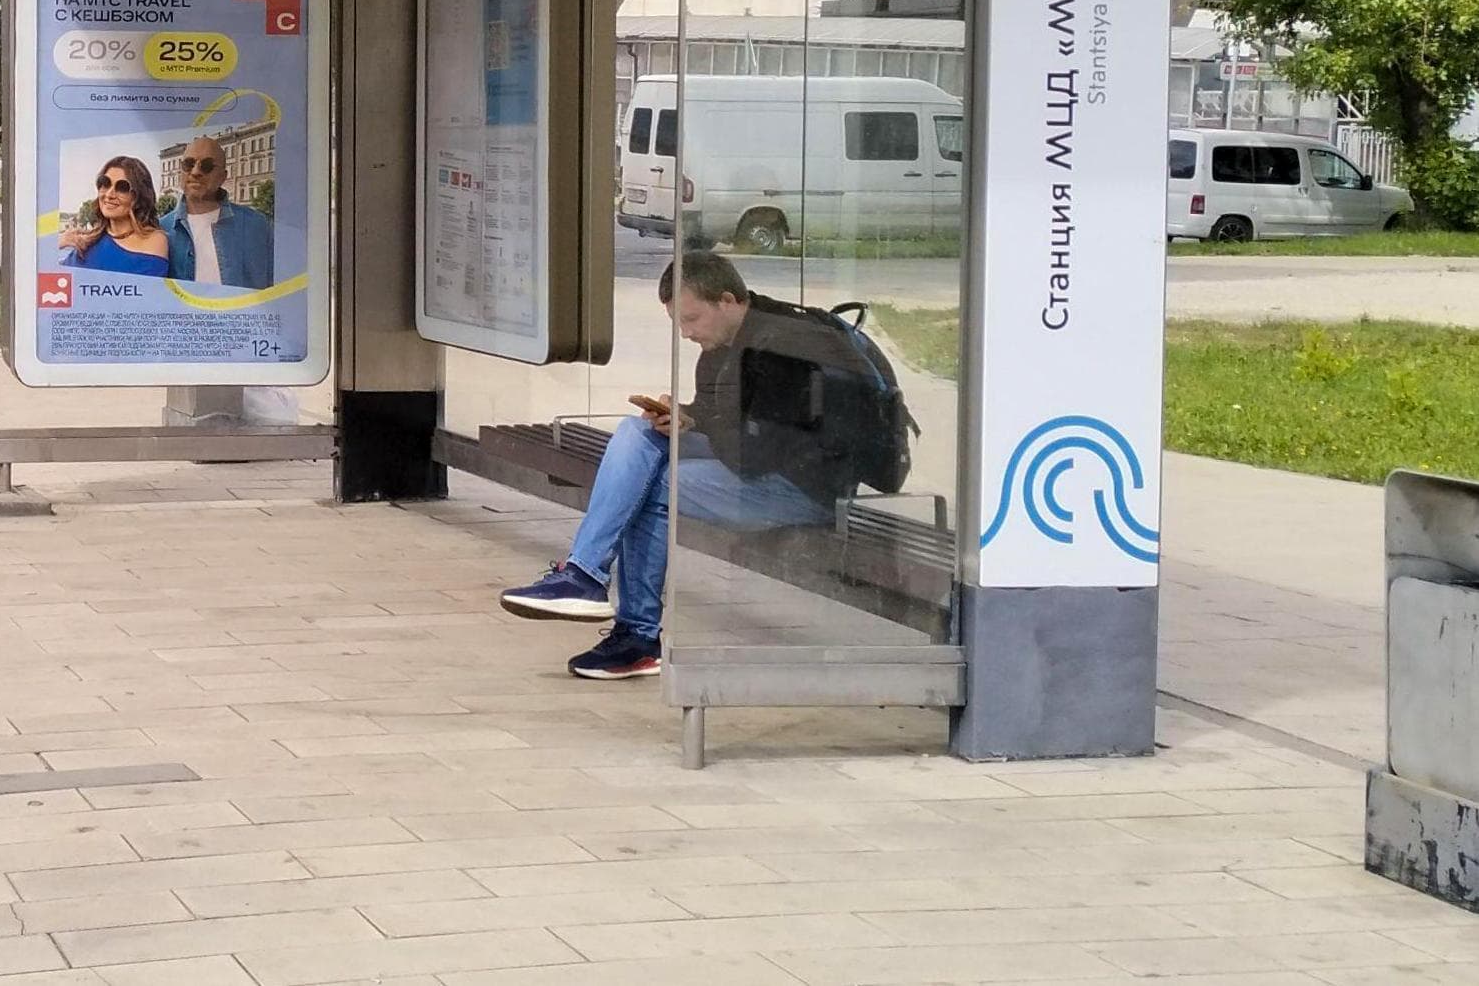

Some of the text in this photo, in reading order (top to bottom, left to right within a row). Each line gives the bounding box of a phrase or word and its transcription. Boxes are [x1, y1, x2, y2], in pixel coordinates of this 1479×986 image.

[55, 9, 174, 23] С КЕШБЭКОМ
[68, 40, 136, 61] 20%
[159, 41, 224, 62] 25%
[1087, 3, 1112, 105] Stantsiya
[185, 65, 221, 73] Premium
[110, 95, 150, 103] лимита
[151, 95, 165, 103] по
[166, 95, 200, 104] сумме
[1045, 68, 1080, 171] МЦД
[1041, 183, 1076, 331] Станция
[79, 284, 143, 297] TRAVEL
[251, 339, 282, 358] 12+
